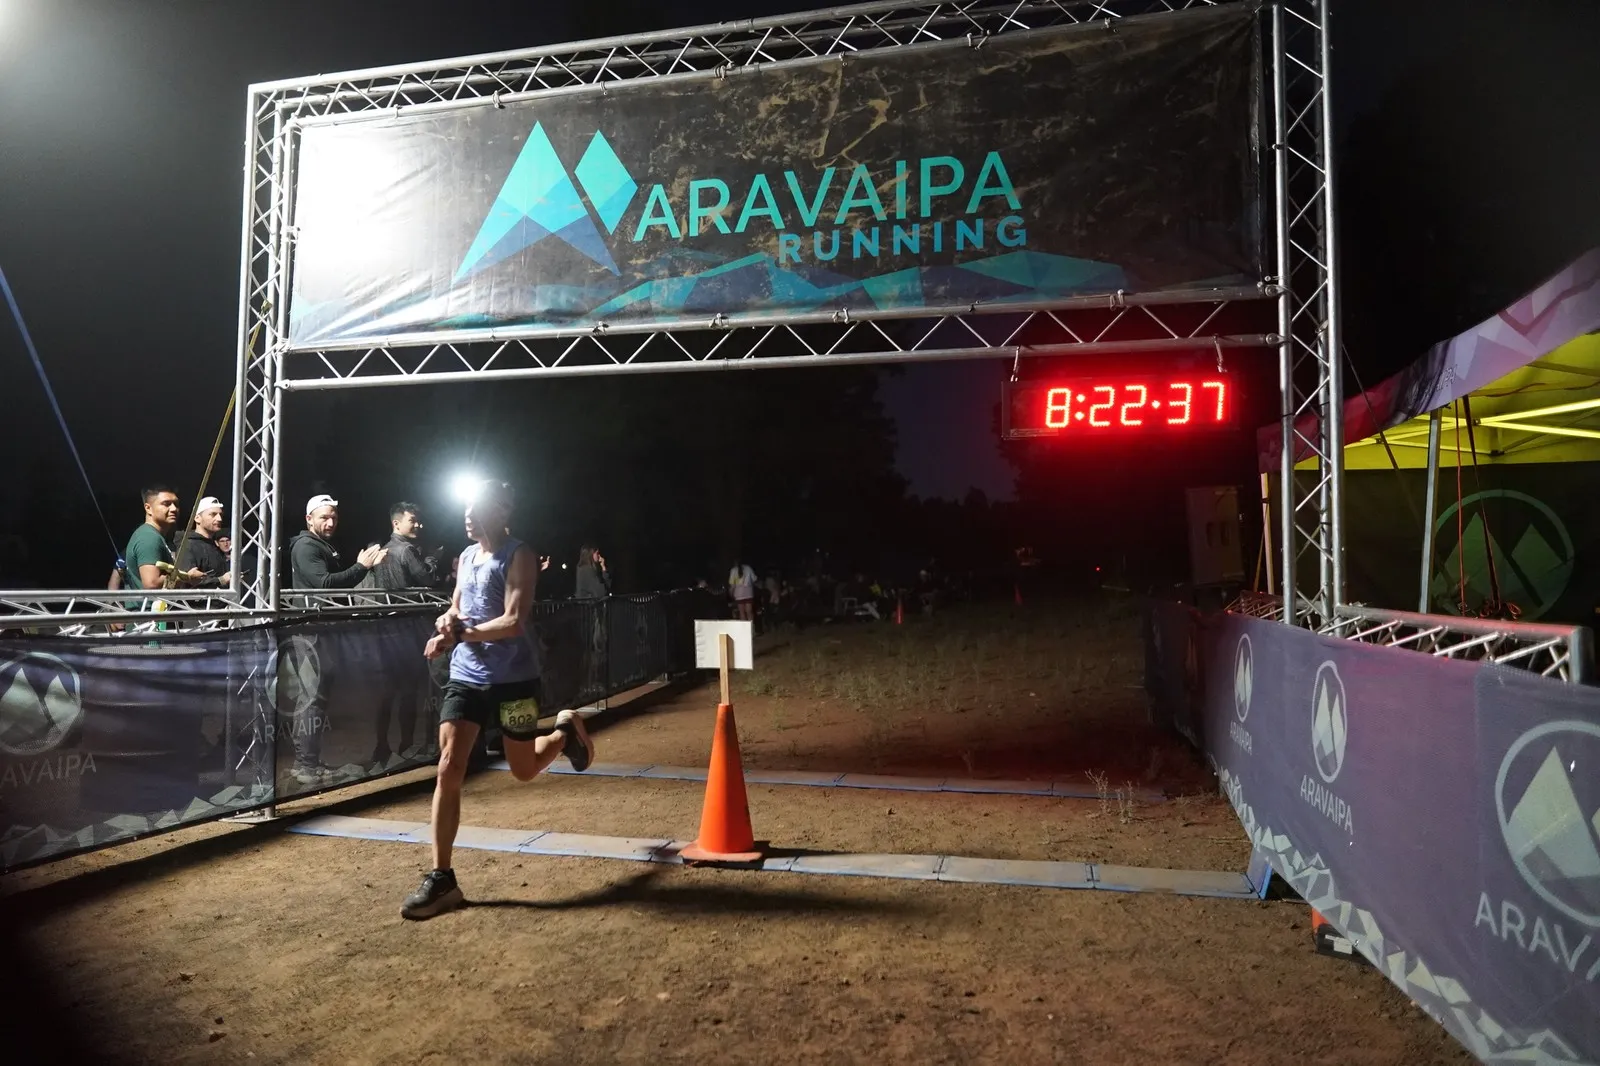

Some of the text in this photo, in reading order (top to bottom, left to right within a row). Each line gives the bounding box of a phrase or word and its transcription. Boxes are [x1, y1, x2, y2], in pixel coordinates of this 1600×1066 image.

[633, 151, 1022, 242] ARAVAIPA
[778, 215, 1027, 264] RUNNING
[253, 715, 332, 744] ARAVAIPA
[508, 714, 533, 728] 802
[1300, 774, 1354, 836] ARAVAIPA
